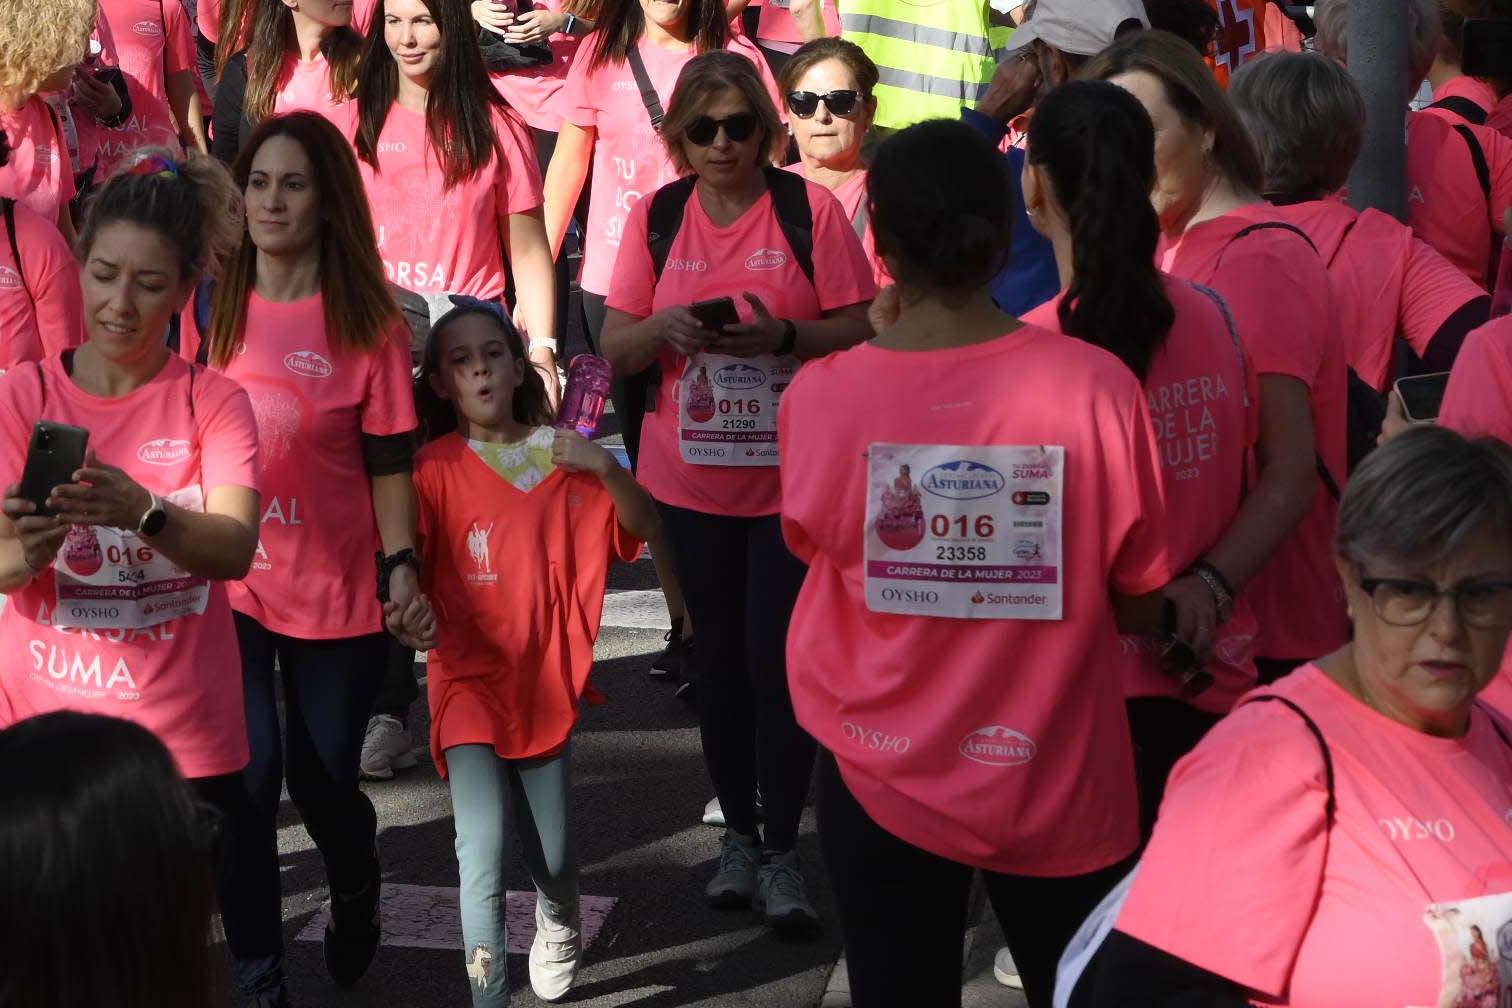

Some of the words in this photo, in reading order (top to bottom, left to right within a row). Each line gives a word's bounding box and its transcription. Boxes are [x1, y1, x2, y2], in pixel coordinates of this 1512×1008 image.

[717, 371, 763, 384] ASTURIANA
[1147, 375, 1230, 412] ARRERA
[718, 399, 761, 414] 016
[722, 419, 756, 429] 21290
[1187, 406, 1217, 435] LA
[689, 447, 725, 458] OYSHO
[927, 473, 999, 490] ASTURIANA
[1012, 469, 1048, 480] SUMA
[930, 514, 995, 538] 016
[106, 545, 153, 566] 016
[936, 546, 987, 562] 23358
[886, 565, 937, 577] CARRERA
[941, 568, 954, 578] DE
[958, 569, 972, 579] LA
[976, 570, 1013, 580] MUJER
[1017, 571, 1042, 580] 2023
[881, 588, 939, 603] OYSHO
[987, 593, 1047, 605] Santander
[71, 607, 120, 618] OYSHO
[29, 640, 137, 689] SUMA
[840, 721, 912, 754] OYSHO
[963, 737, 1032, 760] ASTURIANA
